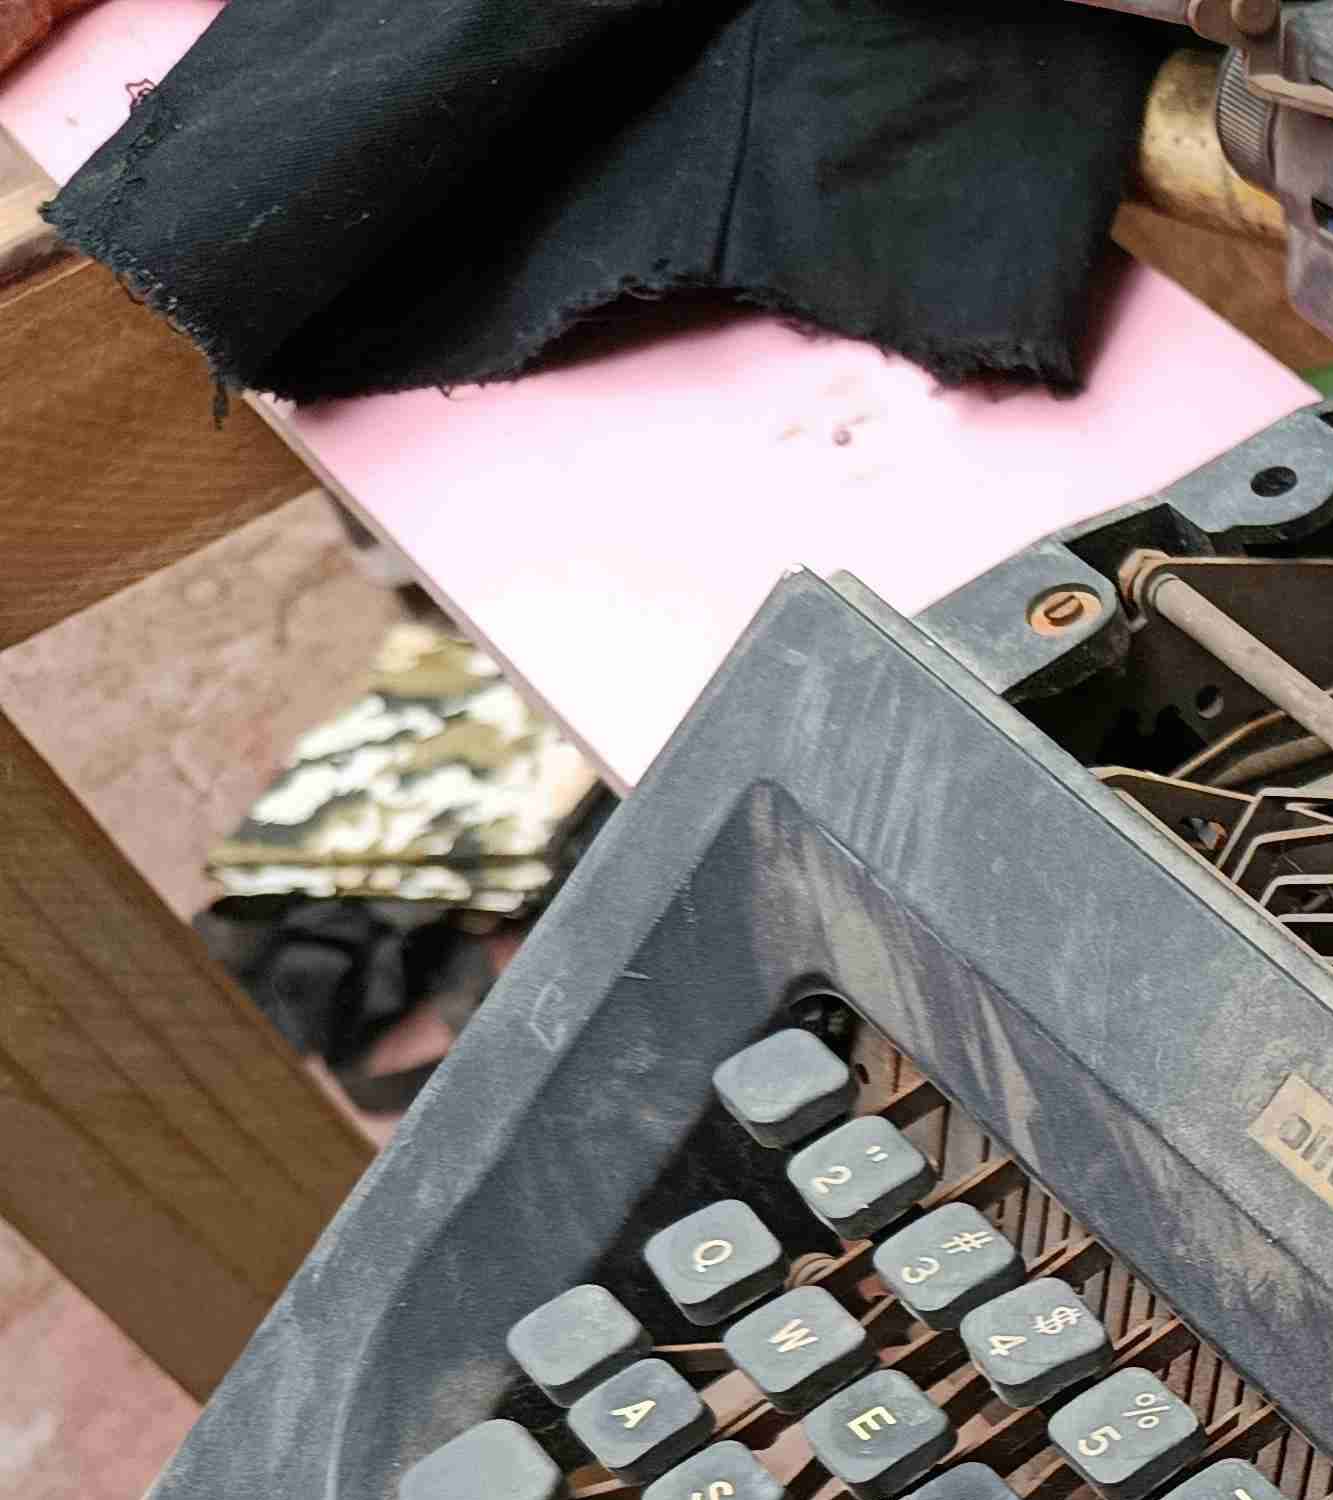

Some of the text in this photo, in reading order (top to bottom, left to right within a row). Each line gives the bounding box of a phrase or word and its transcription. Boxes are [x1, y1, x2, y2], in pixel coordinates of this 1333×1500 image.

[811, 1165, 852, 1194] 2
[693, 1239, 732, 1273] Q
[941, 1231, 993, 1254] #
[901, 1257, 940, 1284] 3
[1033, 1306, 1082, 1335] $
[769, 1318, 819, 1353] W
[988, 1335, 1027, 1356] 4
[611, 1400, 657, 1428] A
[847, 1406, 897, 1441] E
[1121, 1392, 1170, 1429] %
[1078, 1425, 1122, 1456] 5
